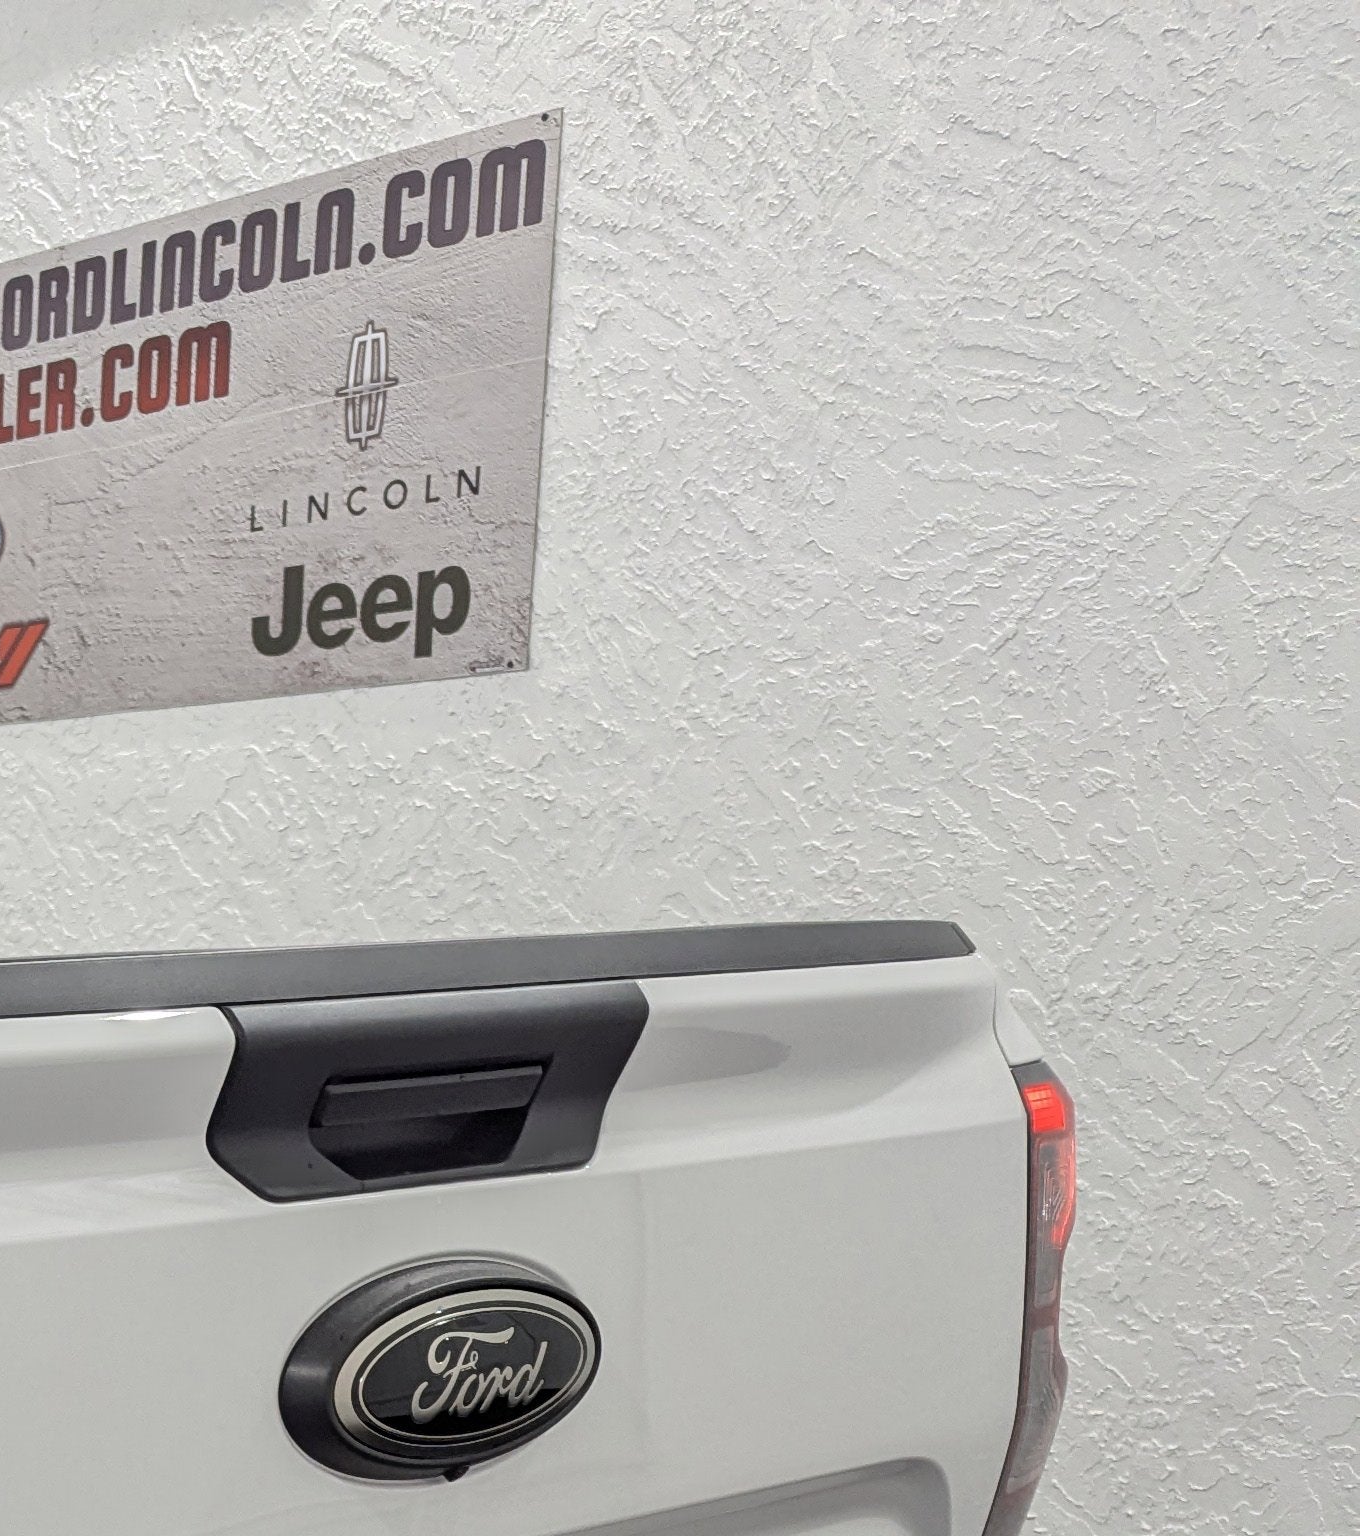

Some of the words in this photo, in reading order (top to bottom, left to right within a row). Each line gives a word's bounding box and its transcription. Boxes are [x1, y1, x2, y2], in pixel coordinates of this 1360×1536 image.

[250, 466, 481, 532] LINCOLN
[251, 565, 471, 659] Jeep
[411, 1326, 548, 1424] Ford
